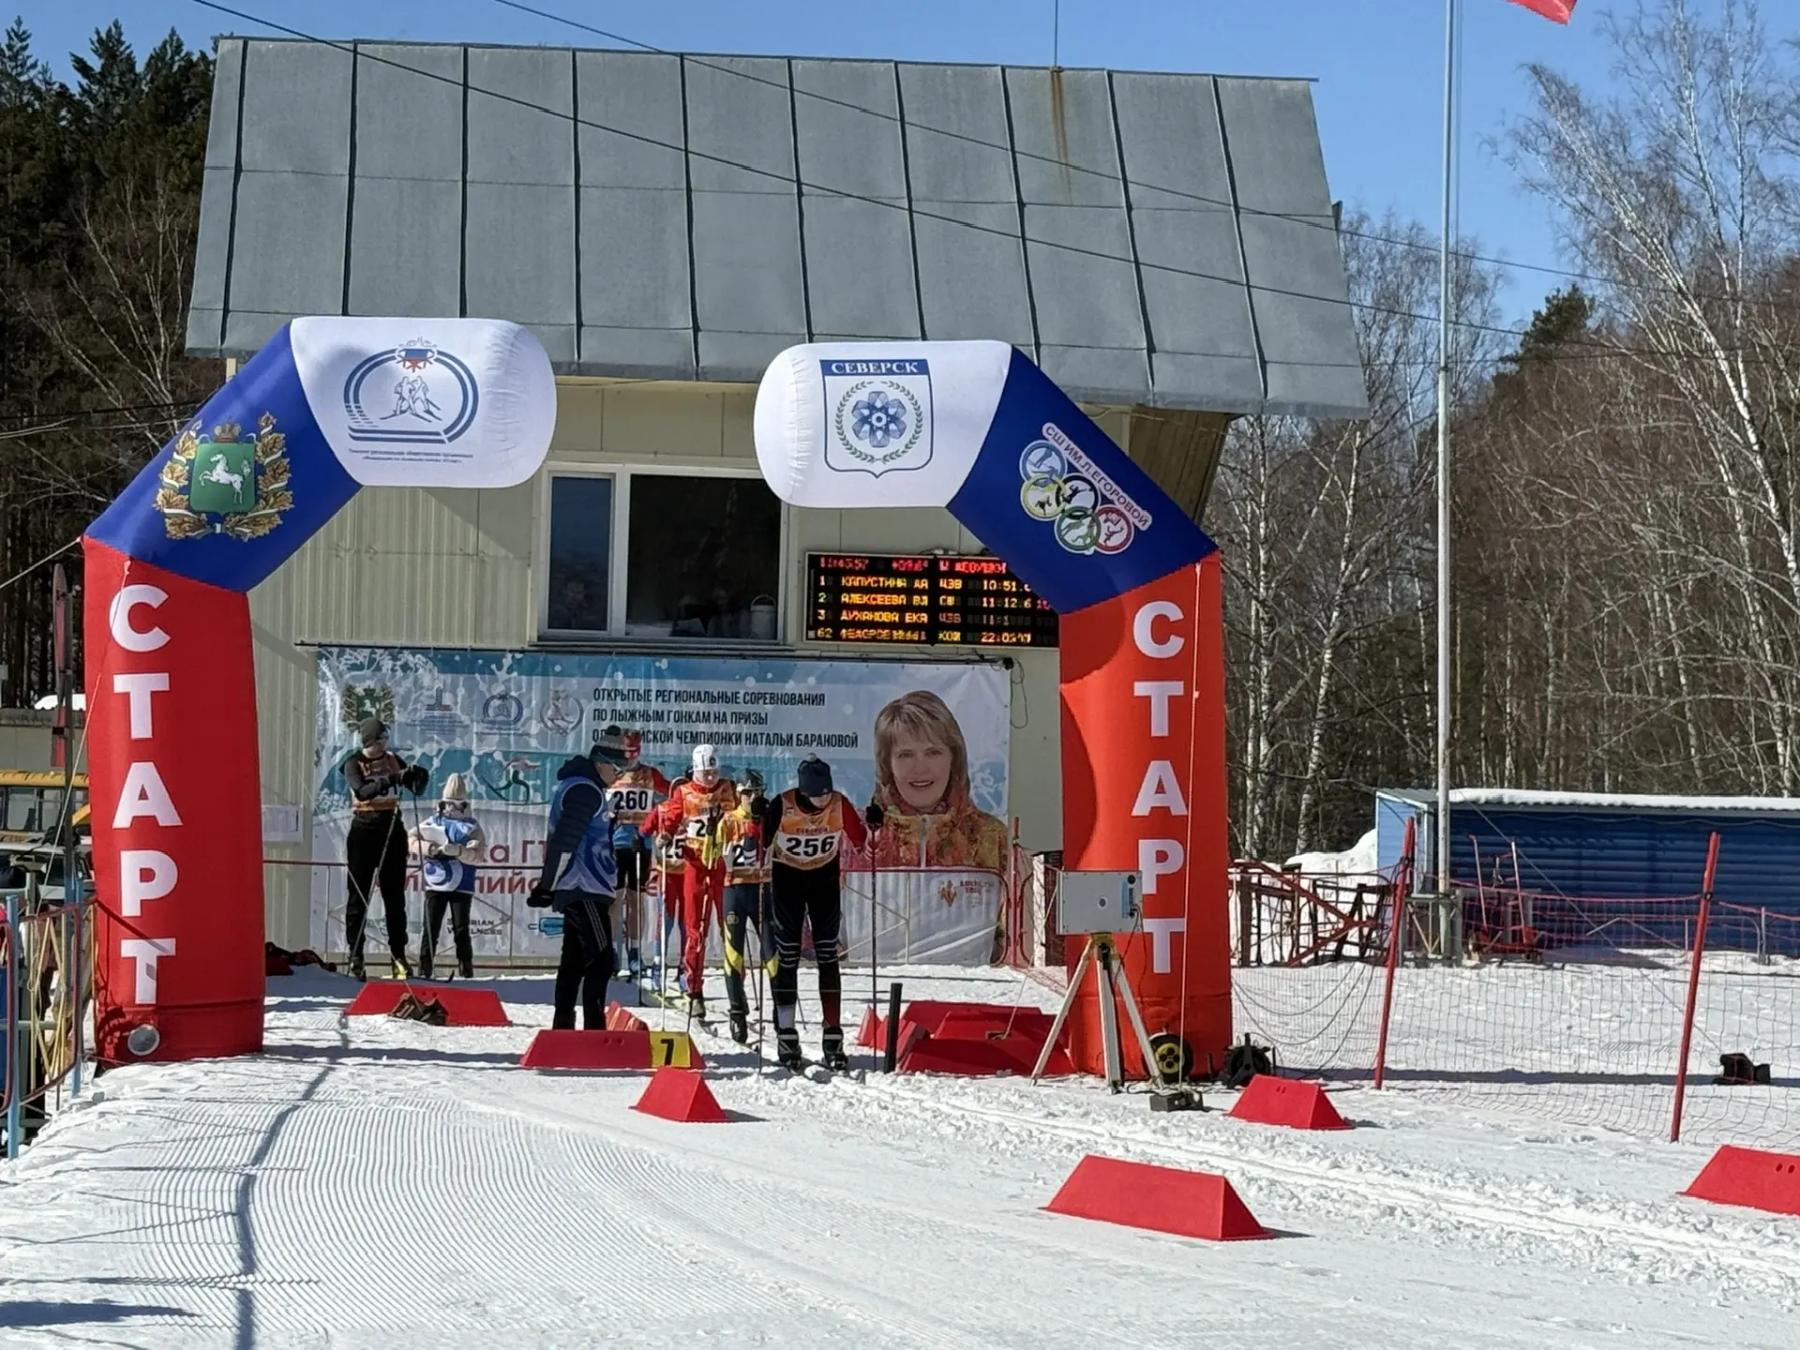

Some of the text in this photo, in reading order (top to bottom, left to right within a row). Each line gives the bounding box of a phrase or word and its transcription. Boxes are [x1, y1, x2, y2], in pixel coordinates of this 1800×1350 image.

[831, 361, 918, 374] СЕВЕРСК
[1045, 425, 1066, 446] СШ
[841, 576, 907, 588] КАПУСТИНА
[818, 592, 827, 603] 2
[841, 593, 907, 606] АЛЕКСЕЕВА
[817, 609, 826, 620] 3
[593, 688, 825, 706] ОТКРЫТЫЕ РЕГИОНАЛЬНЫЕ СОРЕВНОВАНИЯ
[593, 710, 768, 726] ПО ЛЫЖНЫМ ГОНКАМ НА ПРИЗЫ
[676, 731, 742, 746] ЧЕМПИОНКИ
[745, 733, 793, 747] НАТАЛЬИ
[796, 732, 858, 748] БАРАНОВОЙ
[109, 584, 184, 1006] СТАРТ
[1130, 600, 1188, 975] СТАРТ
[614, 791, 648, 811] 260
[786, 836, 835, 857] 256
[661, 1038, 674, 1066] 7
